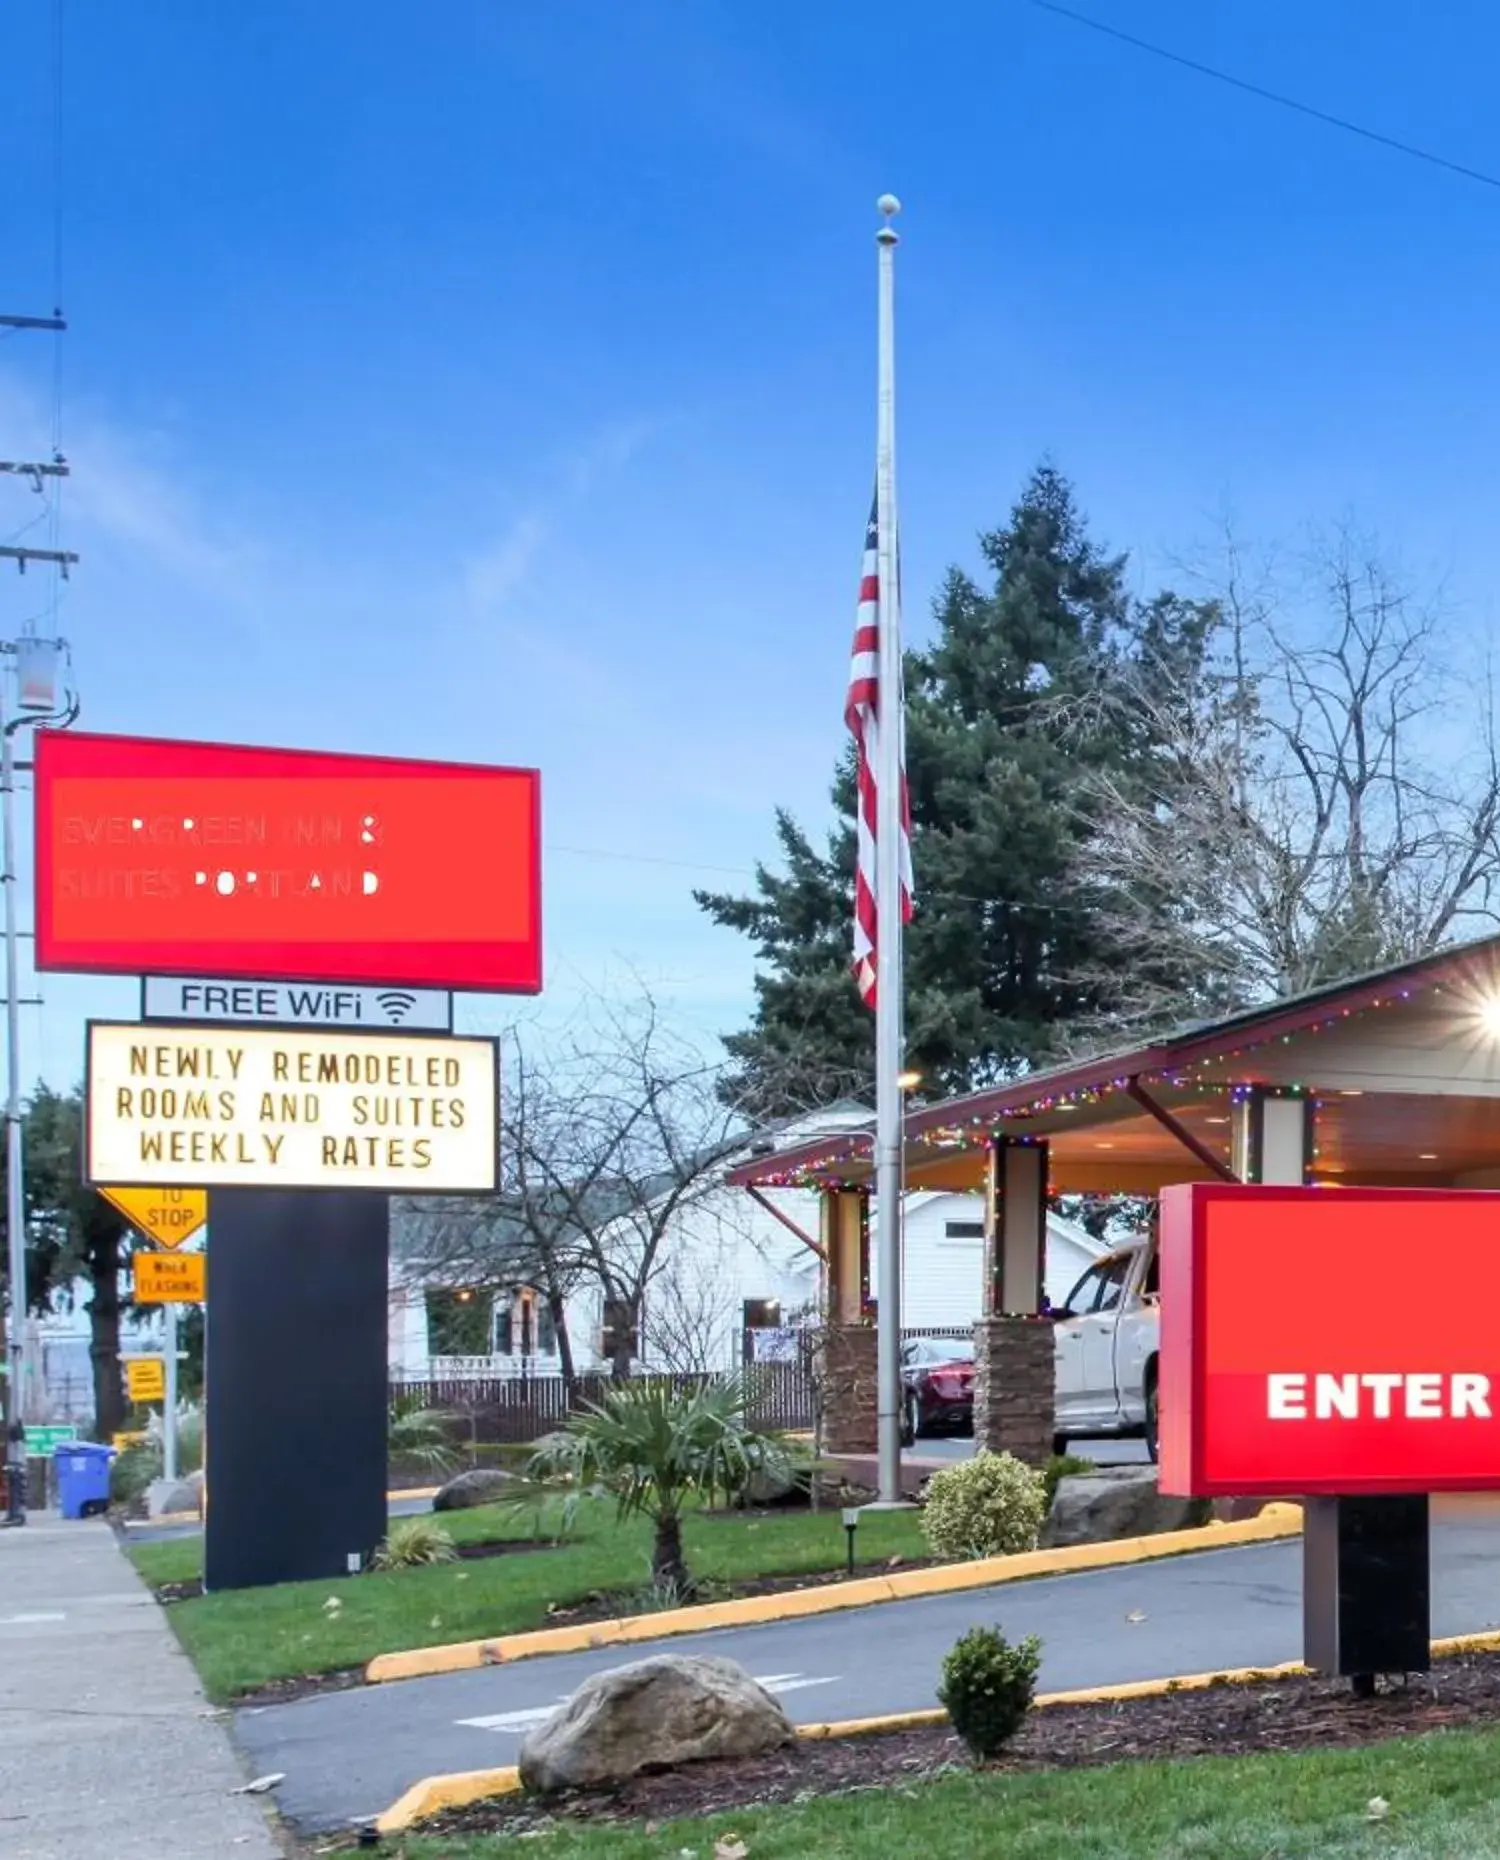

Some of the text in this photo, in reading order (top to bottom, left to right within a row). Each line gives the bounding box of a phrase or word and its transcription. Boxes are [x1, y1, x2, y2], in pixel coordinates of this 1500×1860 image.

[181, 984, 363, 1019] FREE WiFi
[130, 1045, 461, 1088] NEWLY REMODELED
[116, 1086, 466, 1129] ROOMS AND SUITES
[140, 1131, 433, 1169] WEEKLY RATES
[147, 1208, 194, 1226] STOP
[1266, 1373, 1492, 1420] ENTER
